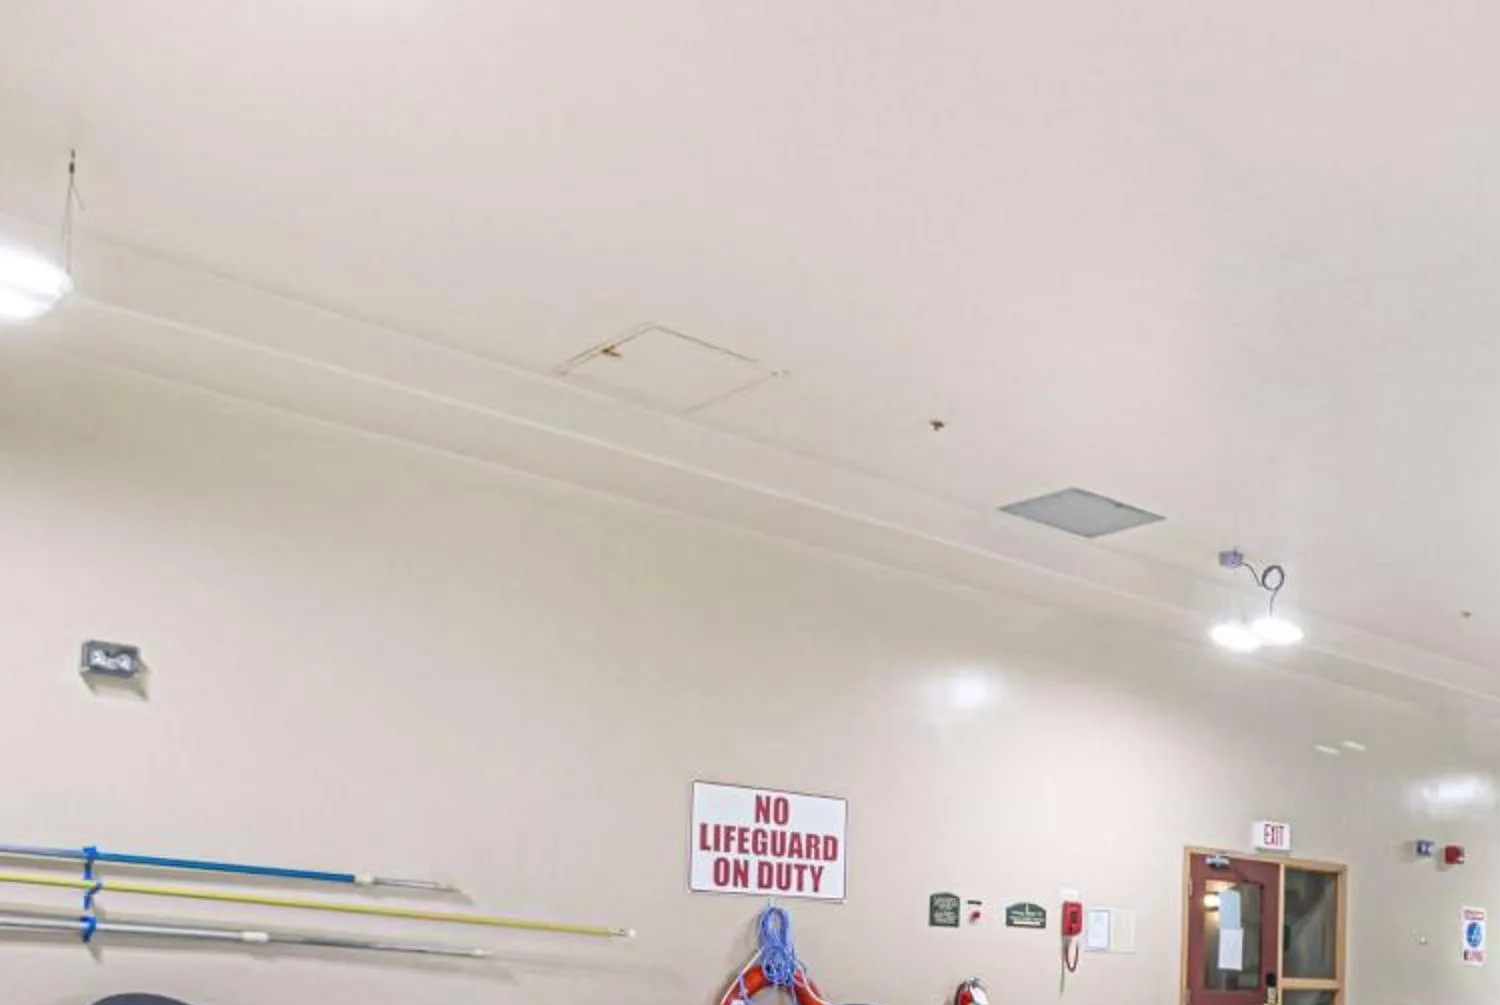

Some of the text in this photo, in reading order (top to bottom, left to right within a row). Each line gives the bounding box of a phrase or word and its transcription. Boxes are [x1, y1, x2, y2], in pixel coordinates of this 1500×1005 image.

[755, 795, 789, 825] NO
[699, 823, 838, 861] LIFEGUARD
[1263, 823, 1285, 846] EXIT
[713, 857, 824, 893] ON DUTY
